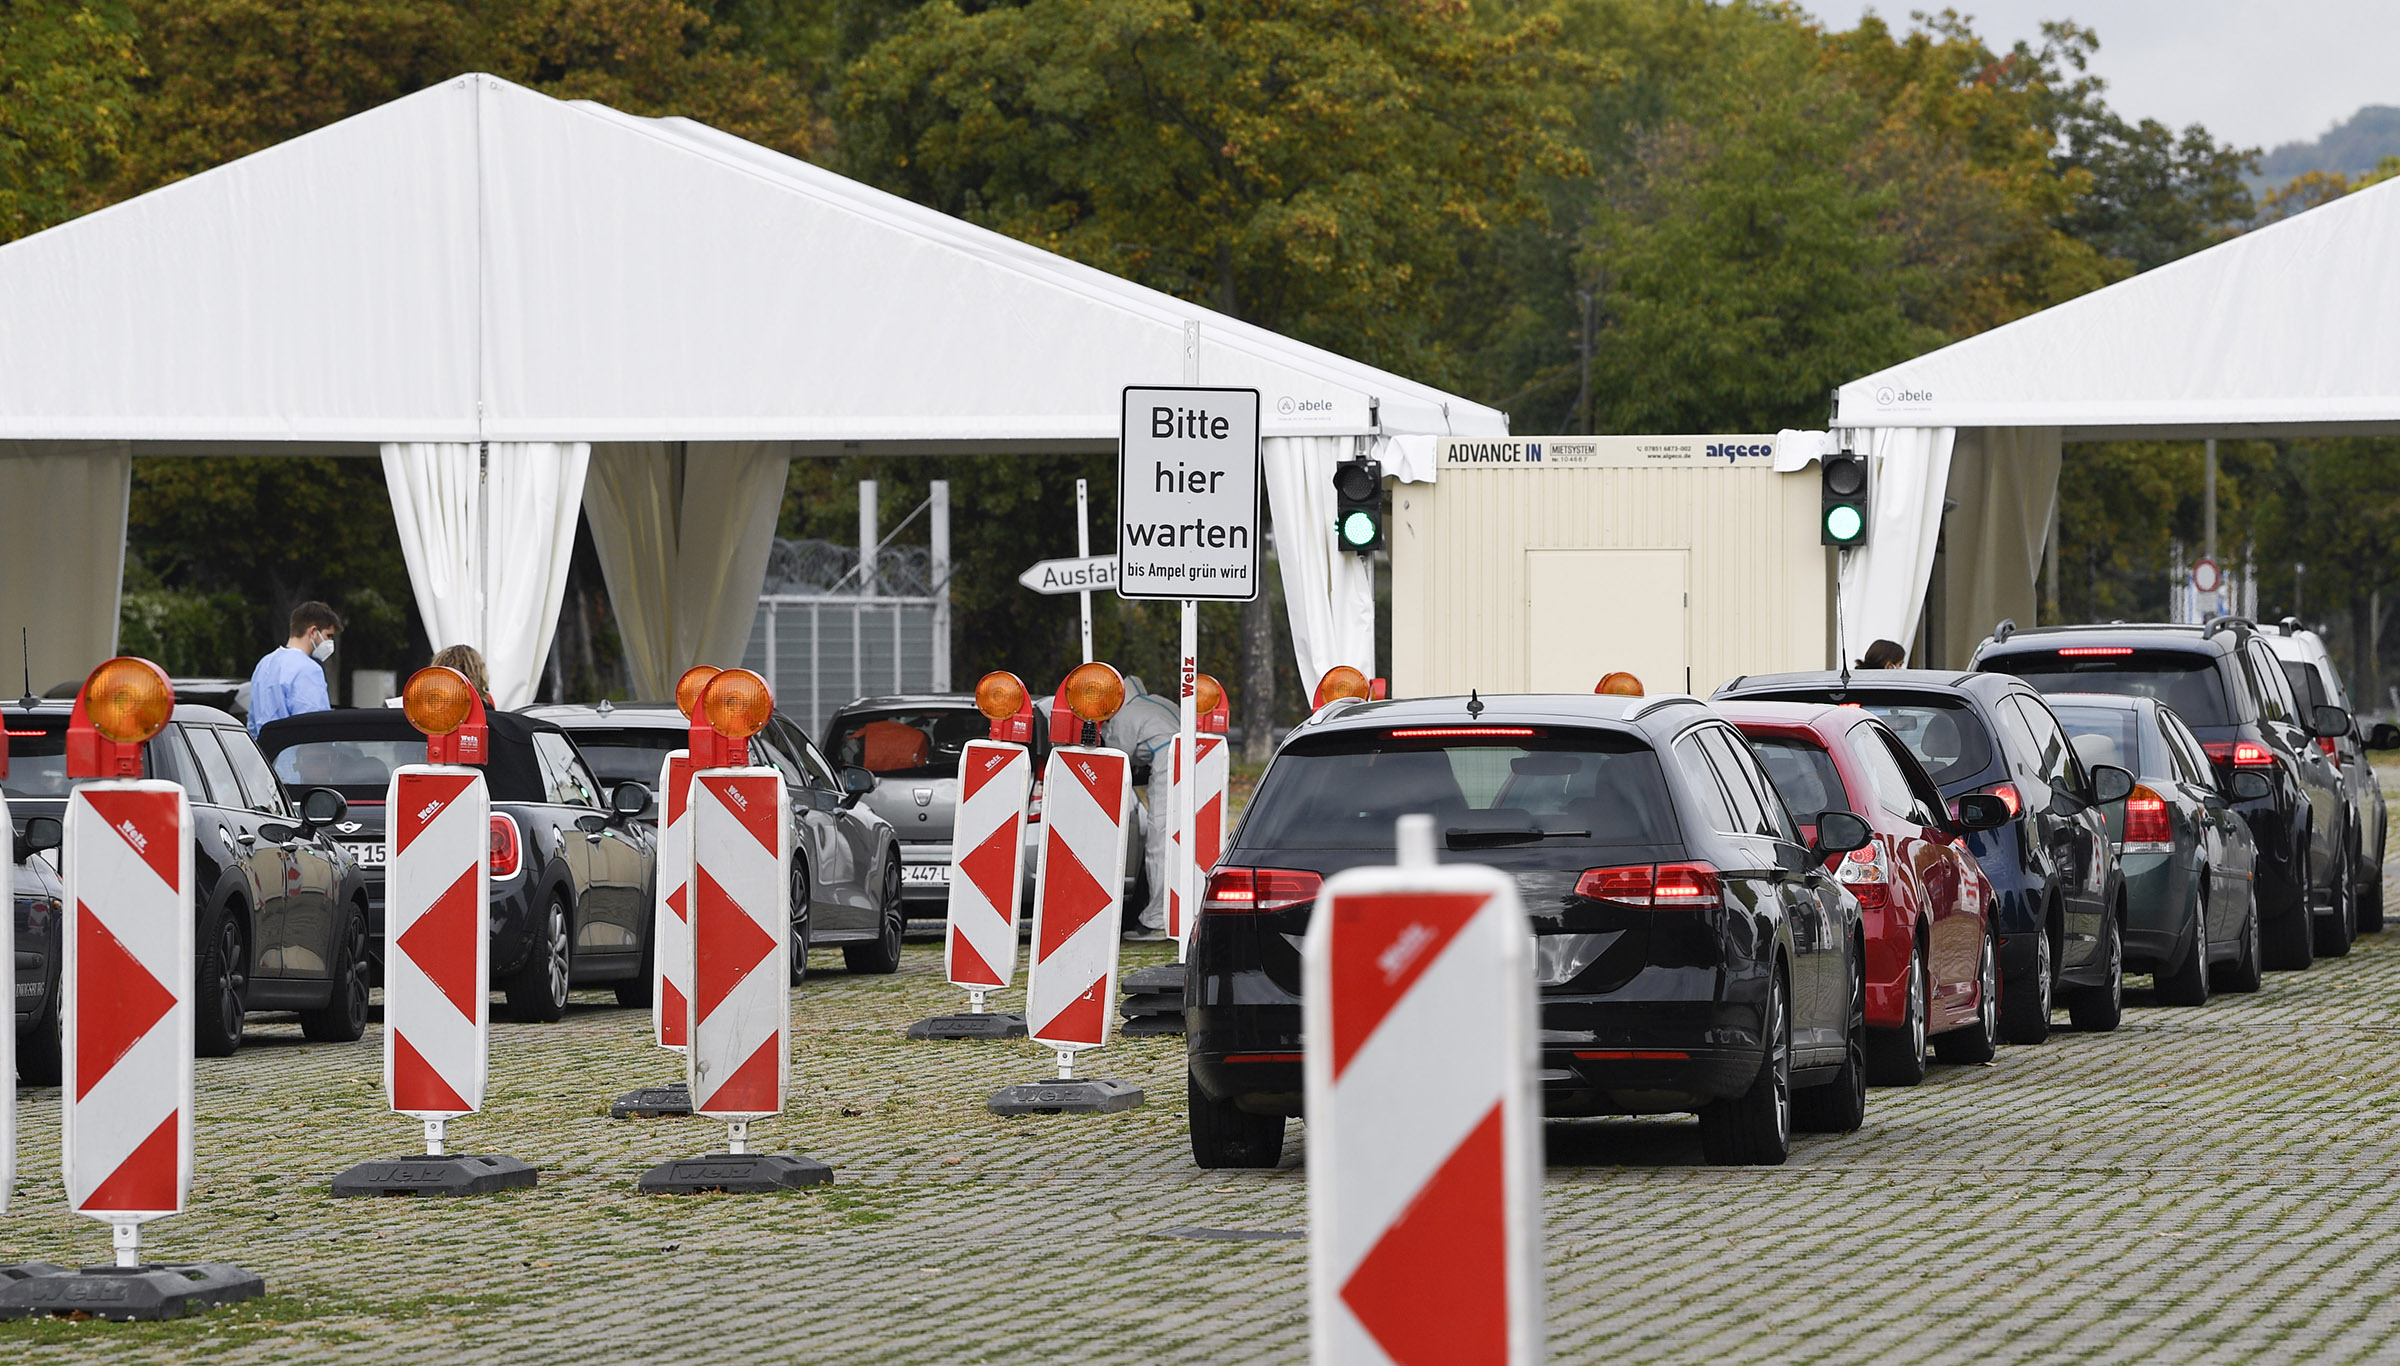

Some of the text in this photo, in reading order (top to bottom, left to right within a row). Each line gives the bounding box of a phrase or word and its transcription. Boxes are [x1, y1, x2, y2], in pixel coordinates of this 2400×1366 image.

[1297, 399, 1333, 411] abele
[1897, 389, 1933, 401] abele
[1151, 406, 1230, 440] Bitte
[1447, 443, 1542, 463] ADVANCE IN
[1551, 445, 1595, 455] MIETSYSTEM
[1705, 443, 1772, 464] algeco
[1155, 461, 1226, 494] hier
[1126, 518, 1249, 549] warten
[1127, 562, 1247, 582] bis Ampel grün wird
[1181, 656, 1195, 698] Welz
[984, 753, 1001, 769] Welz
[1081, 761, 1098, 782] Welz
[727, 784, 748, 808] Welz
[416, 799, 440, 821] Welz
[122, 819, 148, 848] Welz
[343, 845, 359, 862] G
[935, 1020, 986, 1031] Welz
[1016, 1087, 1084, 1102] Welz
[367, 1167, 446, 1182] Welz
[674, 1166, 752, 1179] Welz
[32, 1281, 128, 1301] Welz
